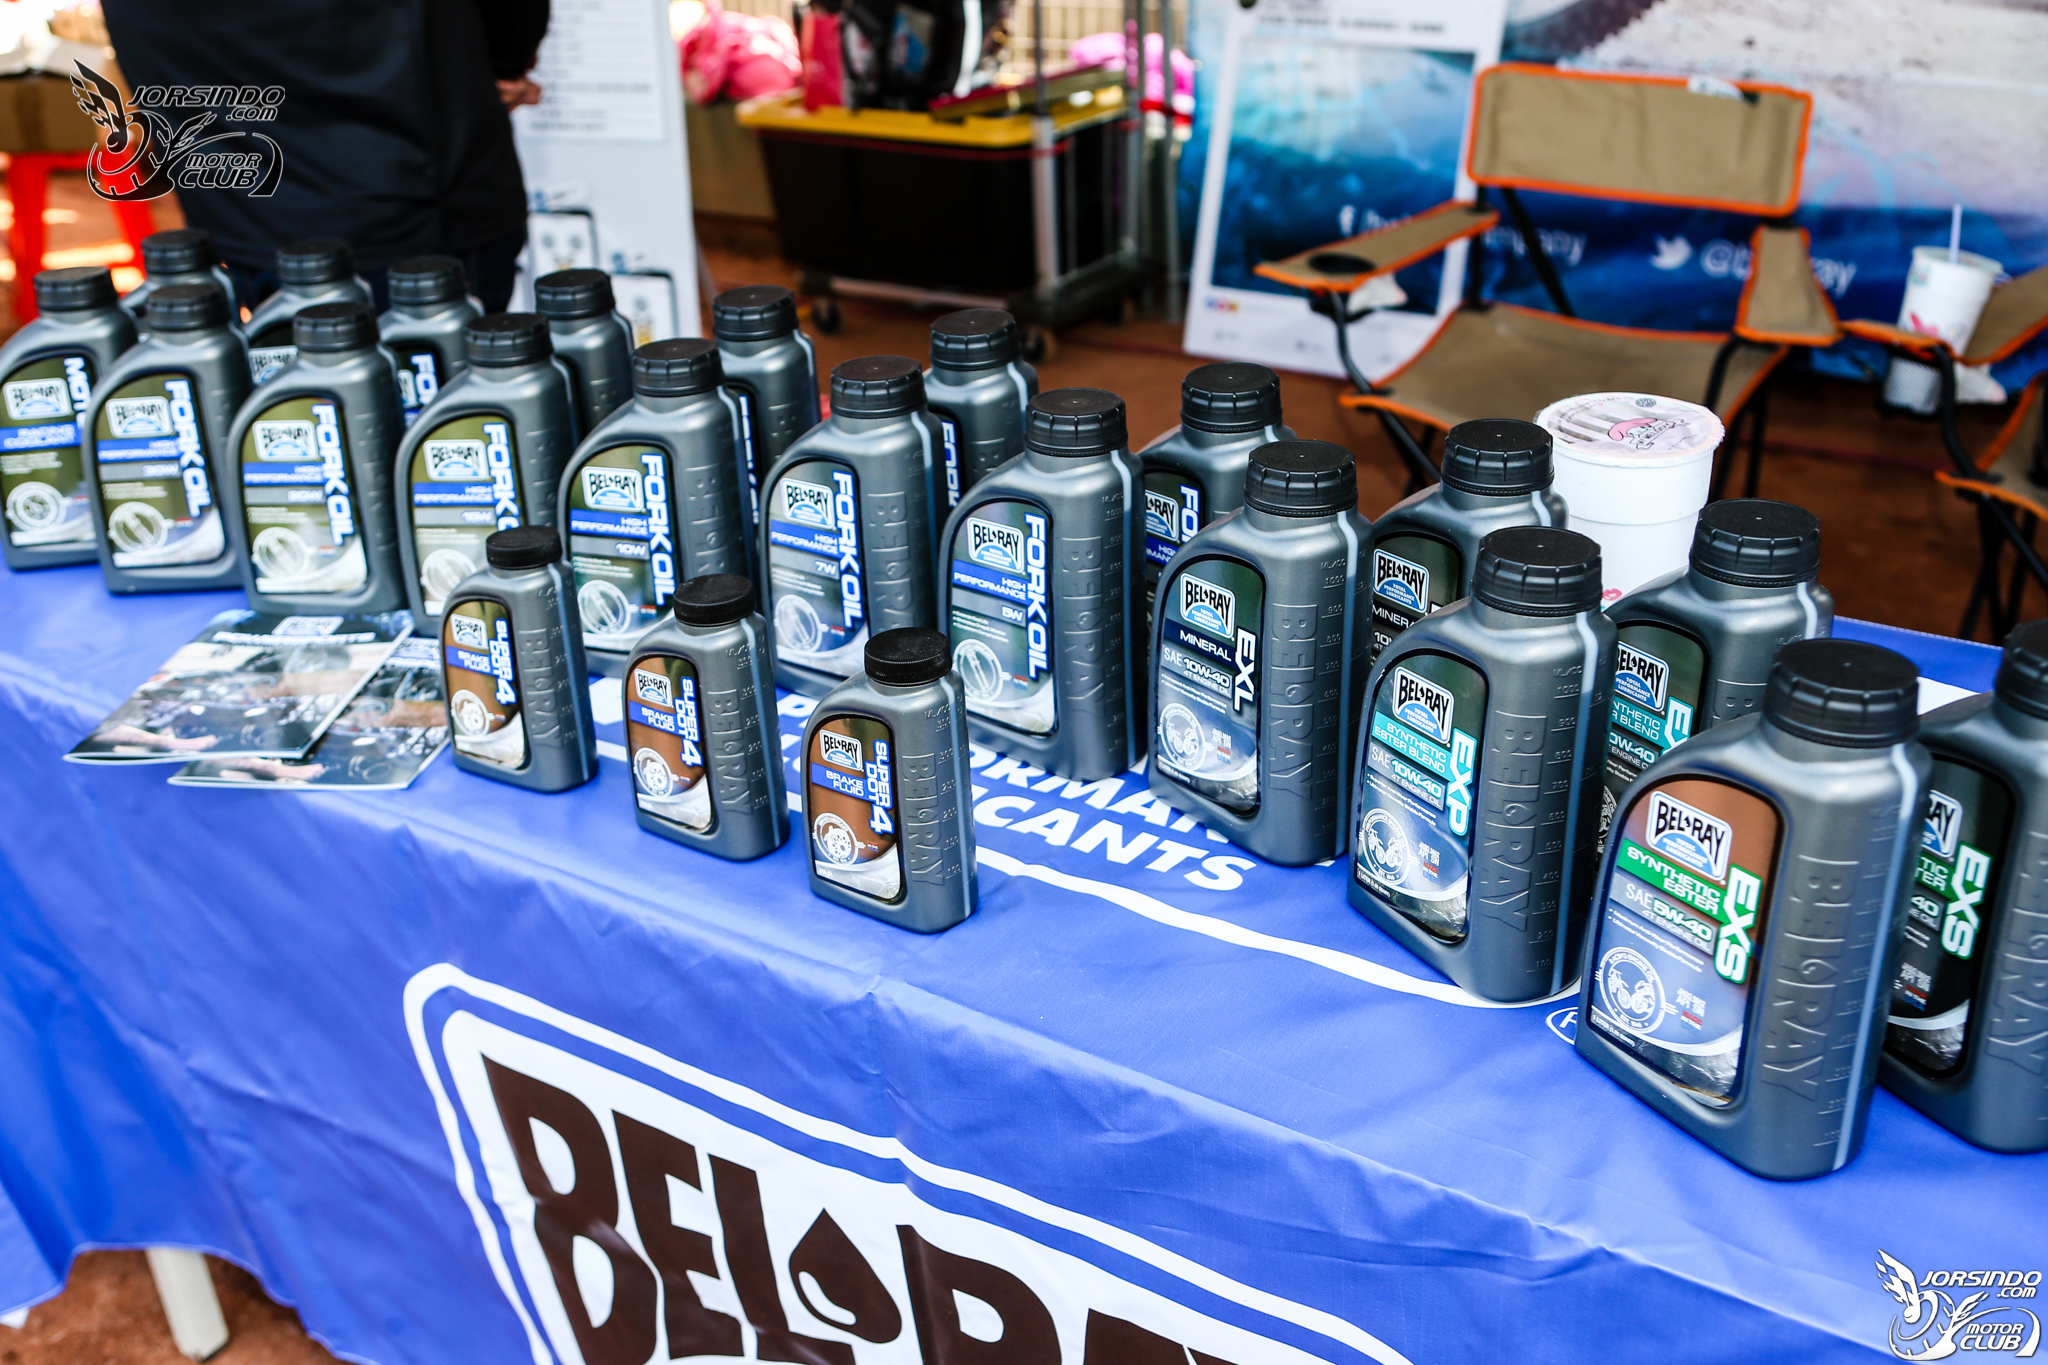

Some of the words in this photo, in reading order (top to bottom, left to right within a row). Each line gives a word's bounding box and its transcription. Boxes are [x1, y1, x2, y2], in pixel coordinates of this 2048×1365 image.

[165, 380, 205, 468] FORK
[312, 405, 349, 495] FORK
[483, 424, 519, 516] FORK
[183, 467, 212, 517] OIL
[414, 493, 493, 503] PERFORMANCE
[641, 455, 672, 552] FORK
[327, 495, 354, 545] OIL
[571, 520, 648, 535] PERFORMANCE
[621, 517, 647, 526] HIGH
[833, 471, 860, 575] FORK
[615, 543, 646, 556] 10W
[771, 531, 838, 554] PERFORMANCE
[814, 533, 838, 546] HIGH
[652, 553, 675, 605] OIL
[815, 560, 836, 574] 7W
[1025, 513, 1048, 625] FORK
[954, 572, 1027, 600] PERFORMANCE
[1002, 577, 1026, 591] HIGH
[1384, 584, 1414, 601] PERFORMANCE
[1386, 590, 1412, 605] LUBRICANTS
[1393, 583, 1406, 592] TOTAL
[841, 574, 863, 628] OIL
[1002, 606, 1023, 621] 5W
[1372, 605, 1415, 628] MINERA
[458, 650, 490, 663] BRAKE
[496, 620, 513, 680] SUPER
[1028, 622, 1048, 679] OIL
[1180, 630, 1231, 662] MINERAL
[464, 660, 490, 673] FLUID
[489, 640, 501, 676] DOT
[496, 679, 516, 704] 4
[1164, 647, 1182, 667] SAE
[1184, 658, 1230, 687] 10W-40
[1234, 628, 1256, 711] EXL
[1193, 674, 1219, 691] ENGINE
[1219, 687, 1230, 696] OIL
[1616, 677, 1650, 698] PERFORMANCE
[1618, 684, 1647, 702] LUBRICANTS
[1626, 677, 1641, 688] TOTAL
[641, 707, 674, 722] BRAKE
[648, 717, 675, 731] FLUID
[675, 699, 688, 738] DOT
[683, 678, 699, 742] SUPER
[1404, 708, 1437, 729] PERFORMANCE
[1407, 715, 1434, 733] LUBRICANTS
[1414, 707, 1428, 719] TOTAL
[1613, 701, 1660, 731] NTHETIC
[1386, 722, 1446, 763] SYNTHETIC
[1621, 715, 1659, 740] BLEND
[681, 739, 702, 766] 4
[1374, 725, 1407, 753] ESTER
[1409, 745, 1445, 774] BLEND
[1610, 732, 1656, 764] 0W-40
[1611, 745, 1640, 766] ENGINE
[826, 770, 864, 788] BRAKE
[833, 781, 864, 796] FLUID
[866, 763, 880, 805] DOT
[876, 741, 891, 807] SUPER
[1371, 747, 1391, 769] SAE
[1391, 760, 1442, 799] 10W-40
[1447, 730, 1476, 835] EXP
[1391, 774, 1400, 782] 4T
[1401, 778, 1428, 800] ENGINE
[1429, 795, 1441, 808] OIL
[870, 806, 893, 833] 4
[1627, 846, 1720, 902] SYNTHETIC
[1663, 878, 1718, 915] ESTER
[1942, 844, 1991, 958] EXS
[1626, 883, 1652, 908] SAE
[1653, 899, 1712, 942] 5W-40
[1716, 867, 1761, 982] EXS
[1656, 915, 1691, 941] ENGINE
[1692, 936, 1711, 953] OIL
